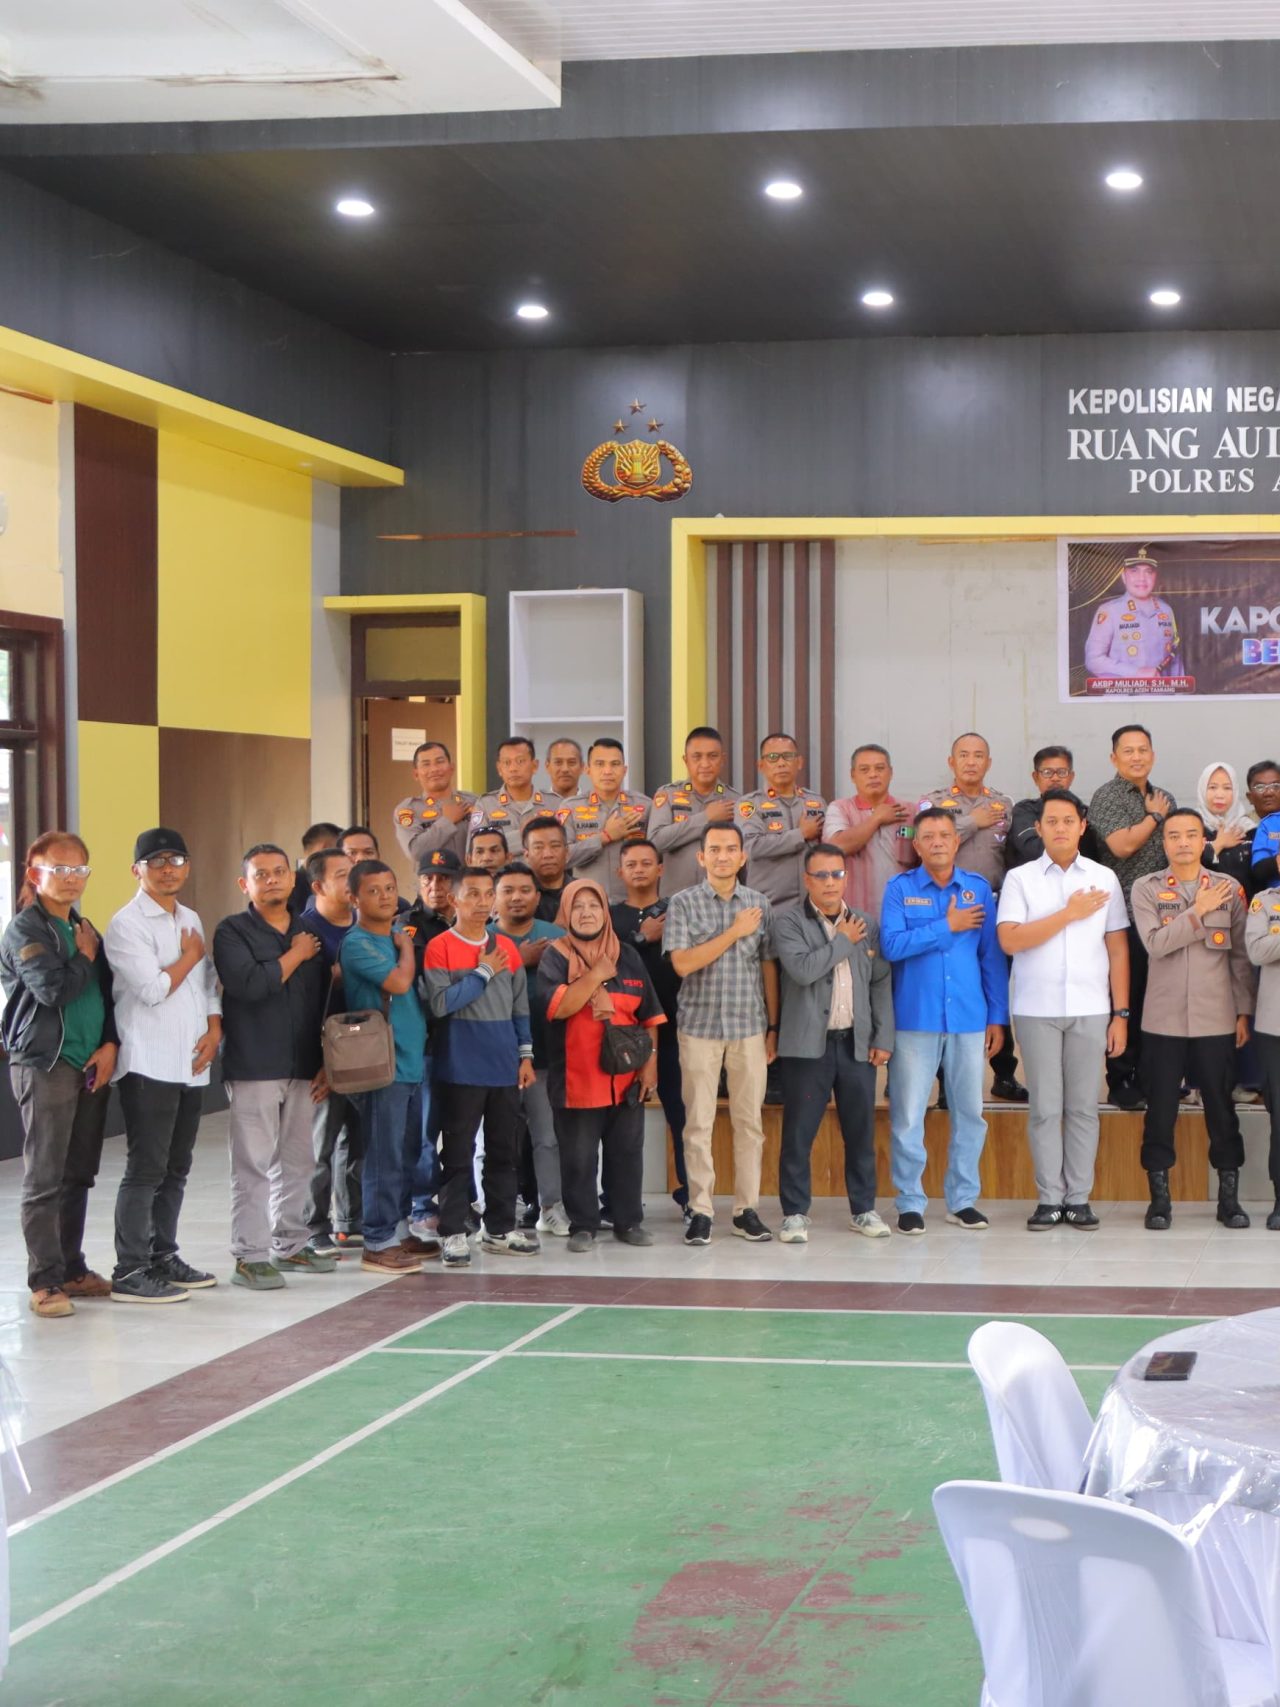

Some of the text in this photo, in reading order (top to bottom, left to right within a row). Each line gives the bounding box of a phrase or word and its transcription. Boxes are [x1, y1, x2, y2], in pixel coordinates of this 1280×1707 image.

[1068, 387, 1213, 415] KEPOLISIAN
[1067, 426, 1201, 461] RUANG
[1128, 468, 1255, 494] POLRES
[1092, 680, 1114, 689] AKBP
